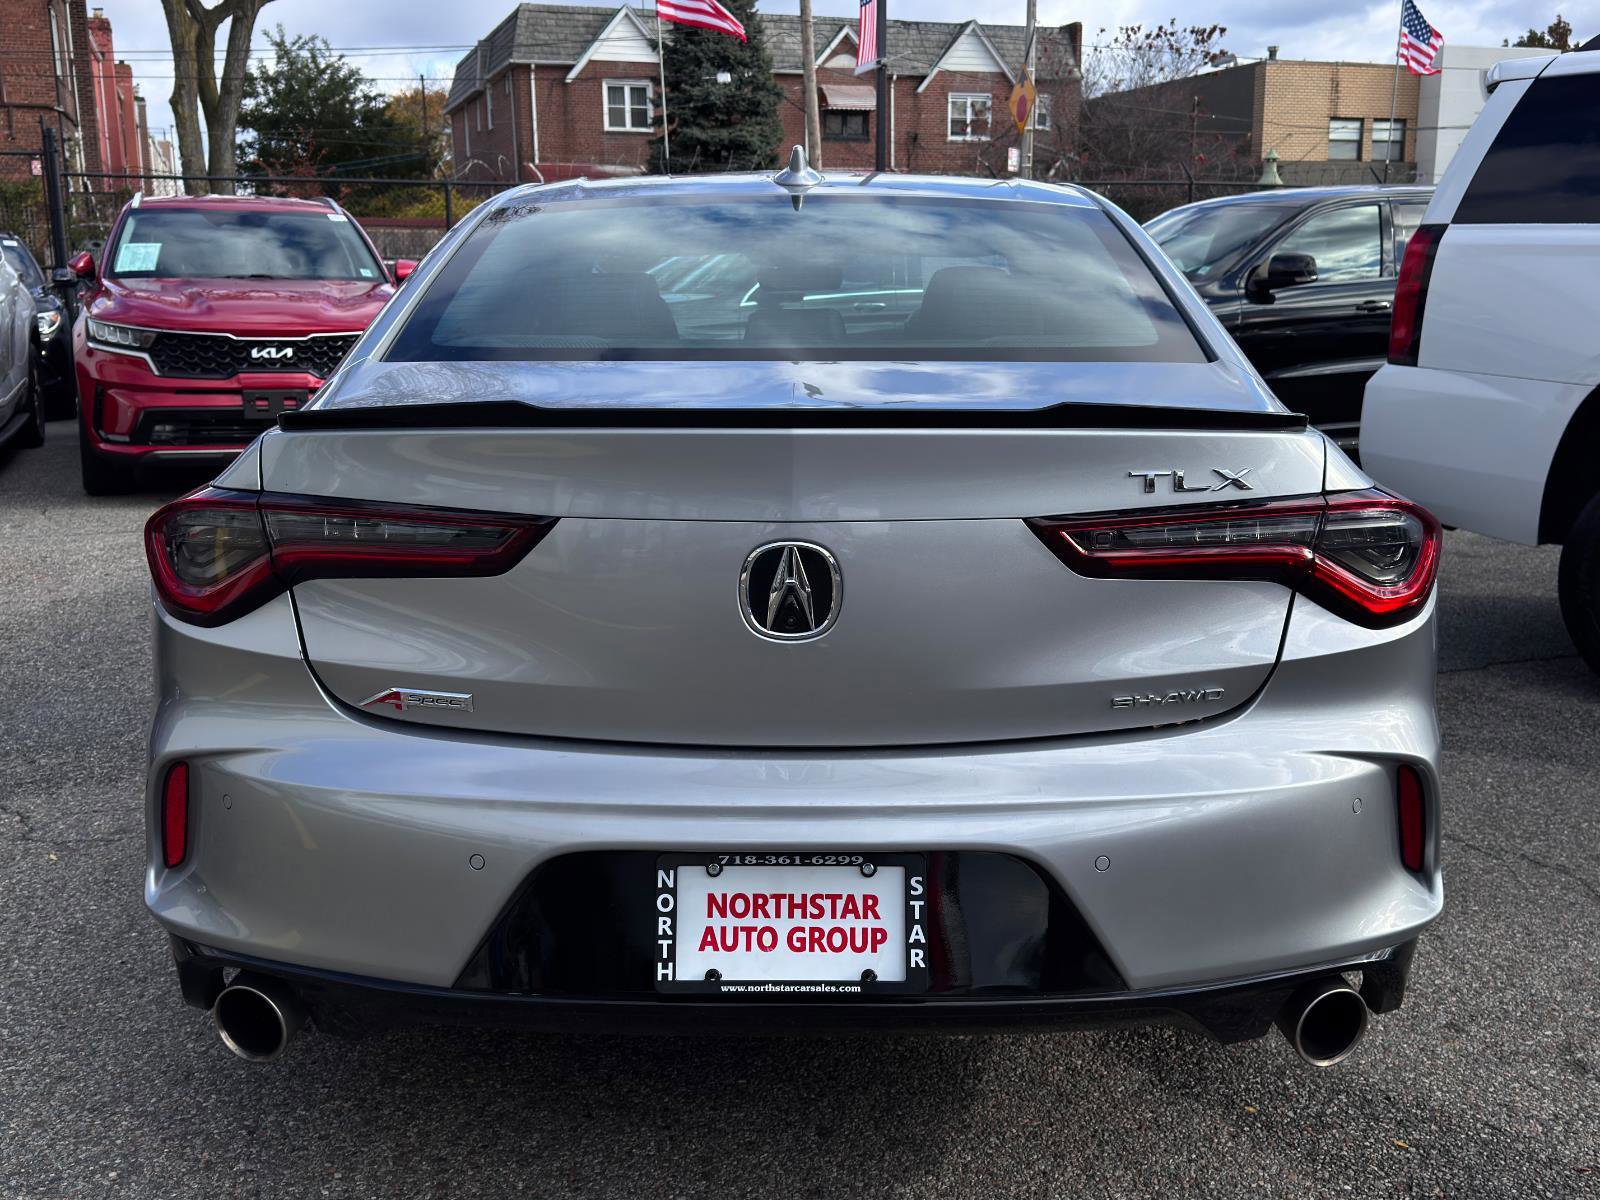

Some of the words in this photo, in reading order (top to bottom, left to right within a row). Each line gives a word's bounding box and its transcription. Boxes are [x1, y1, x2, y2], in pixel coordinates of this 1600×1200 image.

[1128, 467, 1254, 493] TLX
[718, 855, 864, 865] 718-361-6299
[707, 893, 881, 920] NORTHSTAR
[656, 869, 675, 981] NORTH
[908, 876, 926, 968] STAR
[698, 926, 778, 952] AUTO
[786, 927, 888, 954] GROUP
[720, 985, 861, 993] www.northstarcarsales.com
